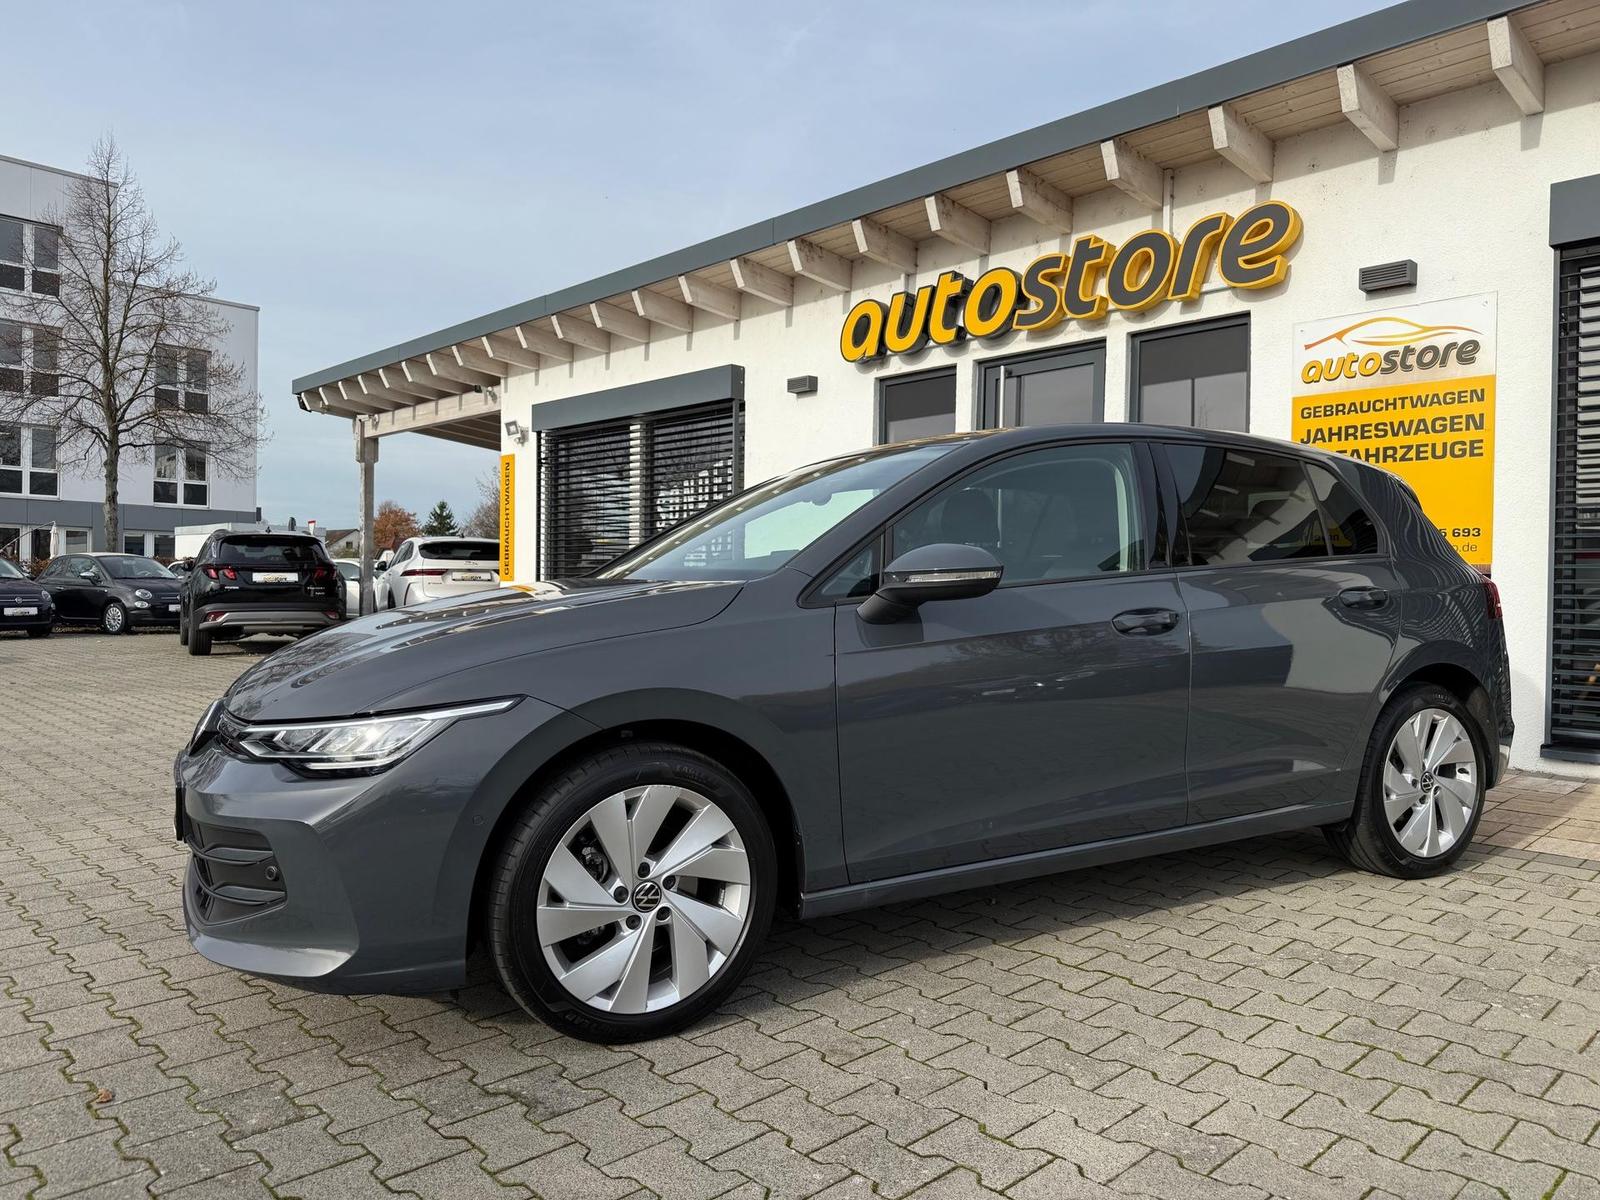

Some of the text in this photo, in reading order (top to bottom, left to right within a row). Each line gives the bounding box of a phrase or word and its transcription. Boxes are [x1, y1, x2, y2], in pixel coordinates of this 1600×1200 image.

[840, 200, 1303, 364] autostore
[1301, 338, 1481, 384] autostore
[1300, 388, 1485, 419] GEBRAUCHTWAGEN
[1300, 413, 1485, 445] JAHRESWAGEN
[1335, 439, 1484, 464] AHRZEUGE
[1452, 527, 1481, 538] 693
